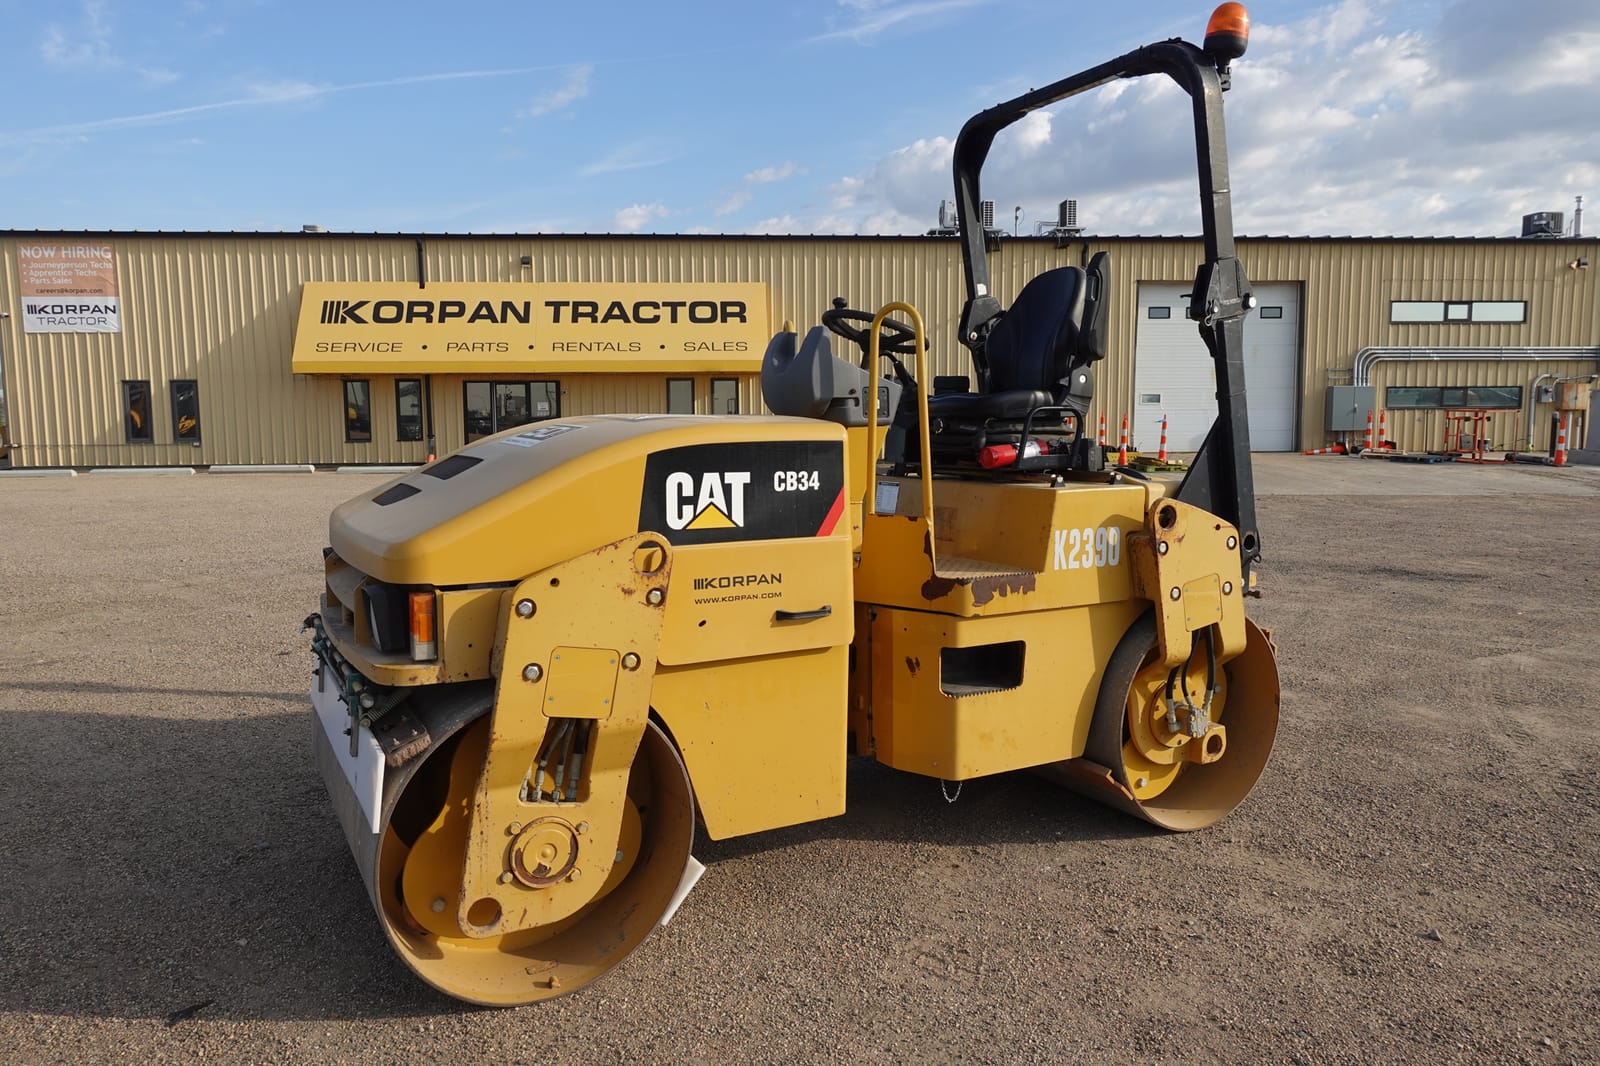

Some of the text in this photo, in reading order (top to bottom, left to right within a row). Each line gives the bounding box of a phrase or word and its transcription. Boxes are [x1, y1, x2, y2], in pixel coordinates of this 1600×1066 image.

[21, 246, 112, 259] NOW HIRING
[29, 261, 113, 270] Journeyperson Techs
[29, 269, 97, 278] Apprentice Techs
[30, 277, 73, 285] Parts Sales
[38, 304, 117, 315] KORPAN
[340, 300, 747, 325] KORPAN TRACTOR
[37, 316, 108, 326] TRACTOR
[315, 341, 748, 353] SERVICE PARTS RENTALS SALES
[773, 470, 820, 492] CB34
[665, 471, 751, 530] CAT
[1053, 526, 1120, 571] K2390
[704, 572, 782, 590] KORPAN
[694, 591, 782, 605] WWW.KORPAN.COM
